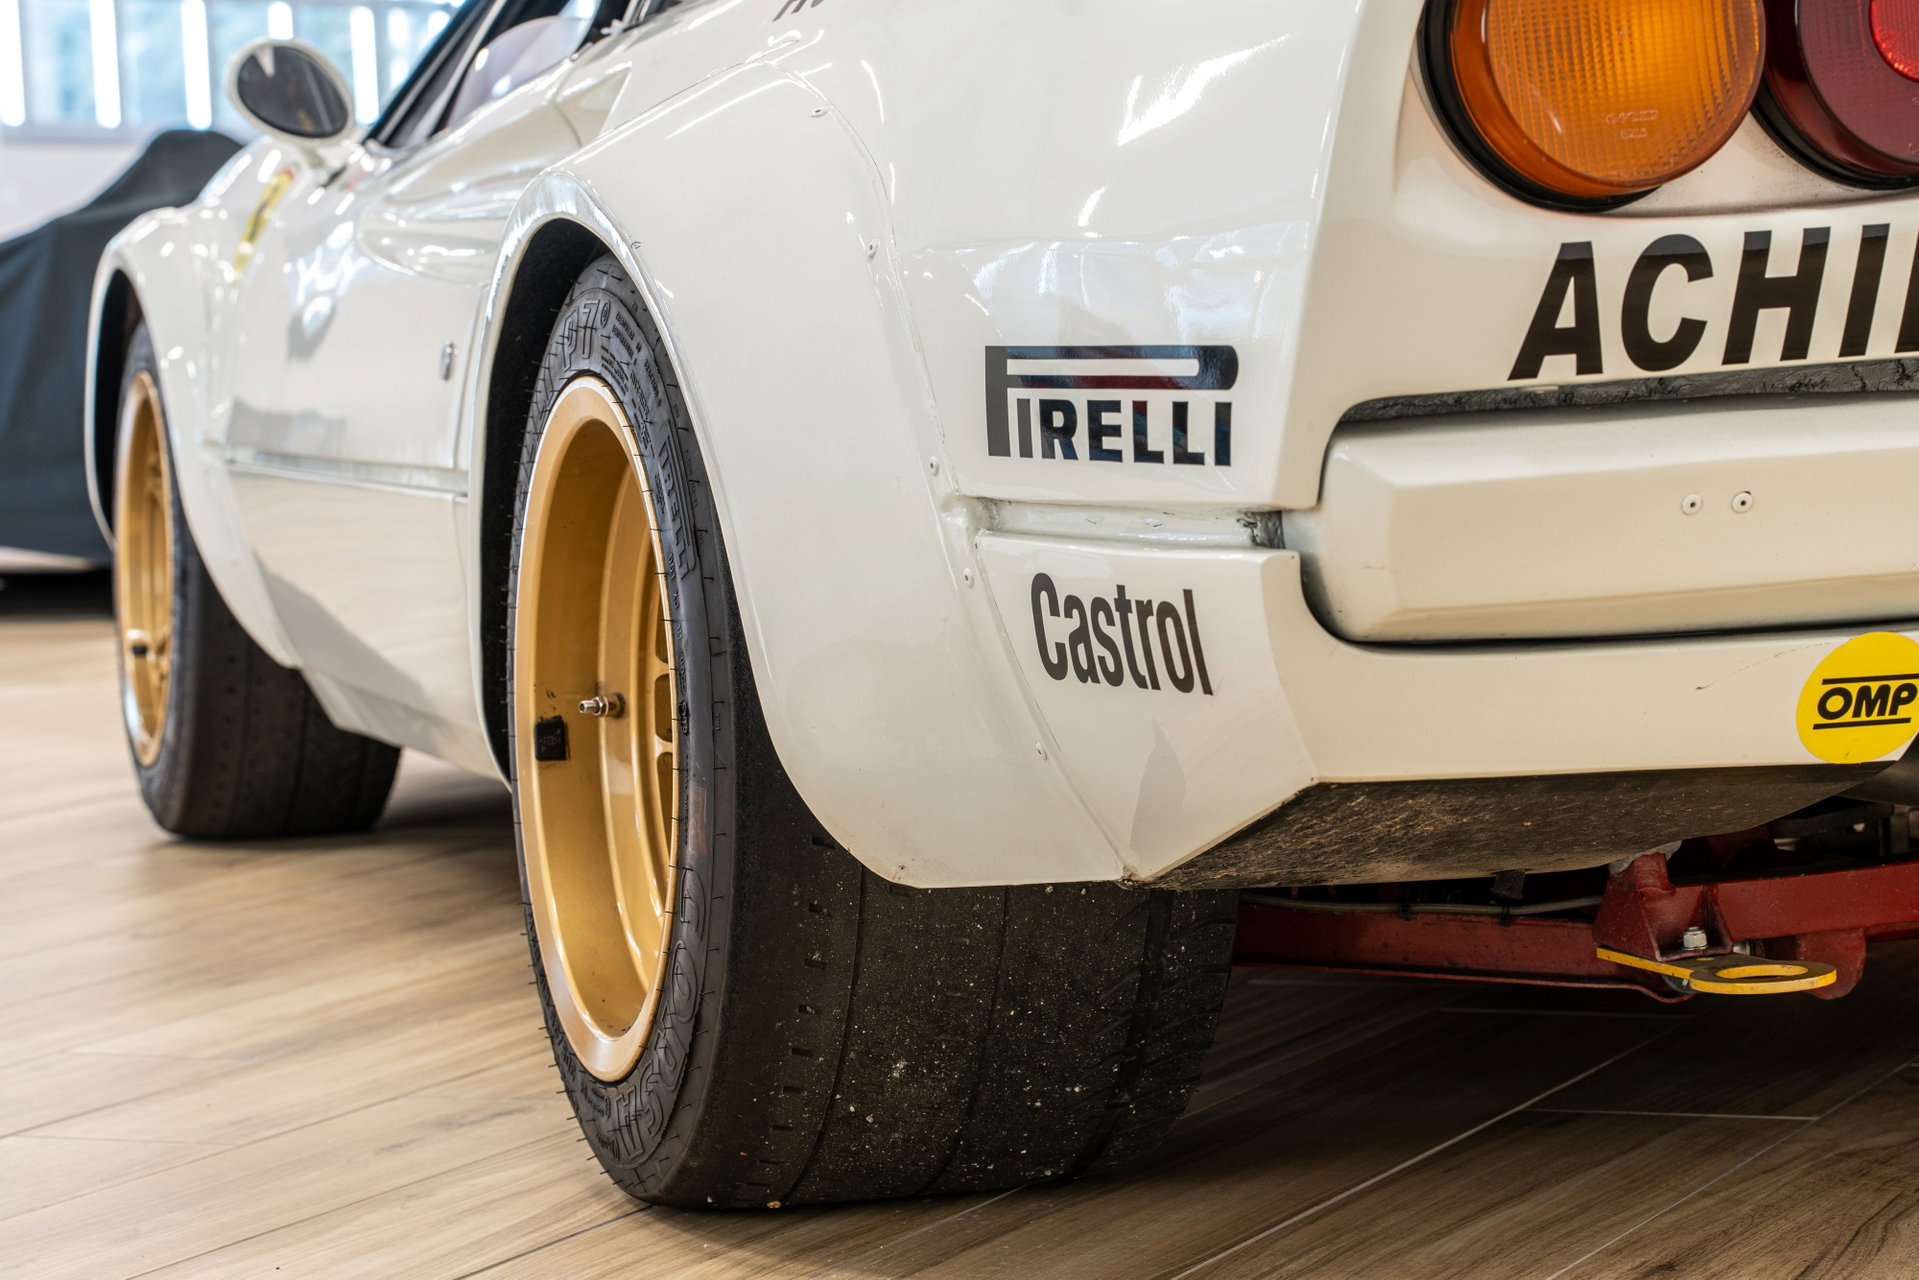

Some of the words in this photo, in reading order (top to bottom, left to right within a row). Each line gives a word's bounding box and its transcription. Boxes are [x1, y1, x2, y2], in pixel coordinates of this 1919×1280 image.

[985, 345, 1239, 467] PIRELLI
[1031, 572, 1214, 696] Castrol
[1816, 682, 1918, 720] OMP
